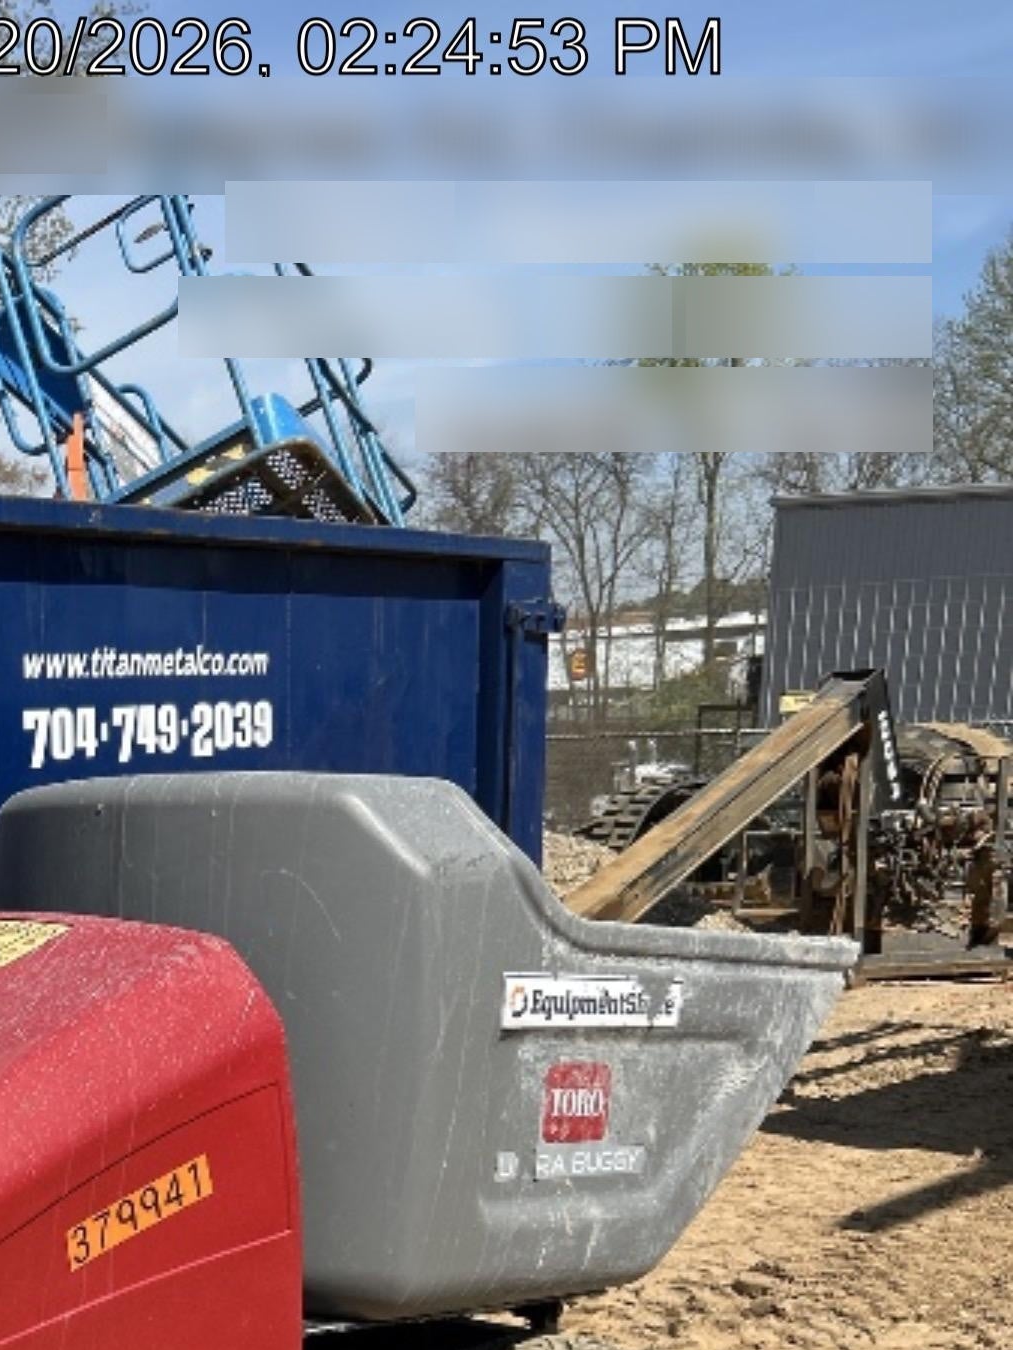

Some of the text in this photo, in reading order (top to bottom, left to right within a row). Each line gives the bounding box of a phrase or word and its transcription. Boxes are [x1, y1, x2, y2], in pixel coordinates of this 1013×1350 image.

[22, 645, 270, 680] www.titanmetalco.com
[551, 1088, 605, 1117] TORO
[496, 1150, 640, 1178] DRA BUGGY
[71, 1161, 202, 1264] 379941
